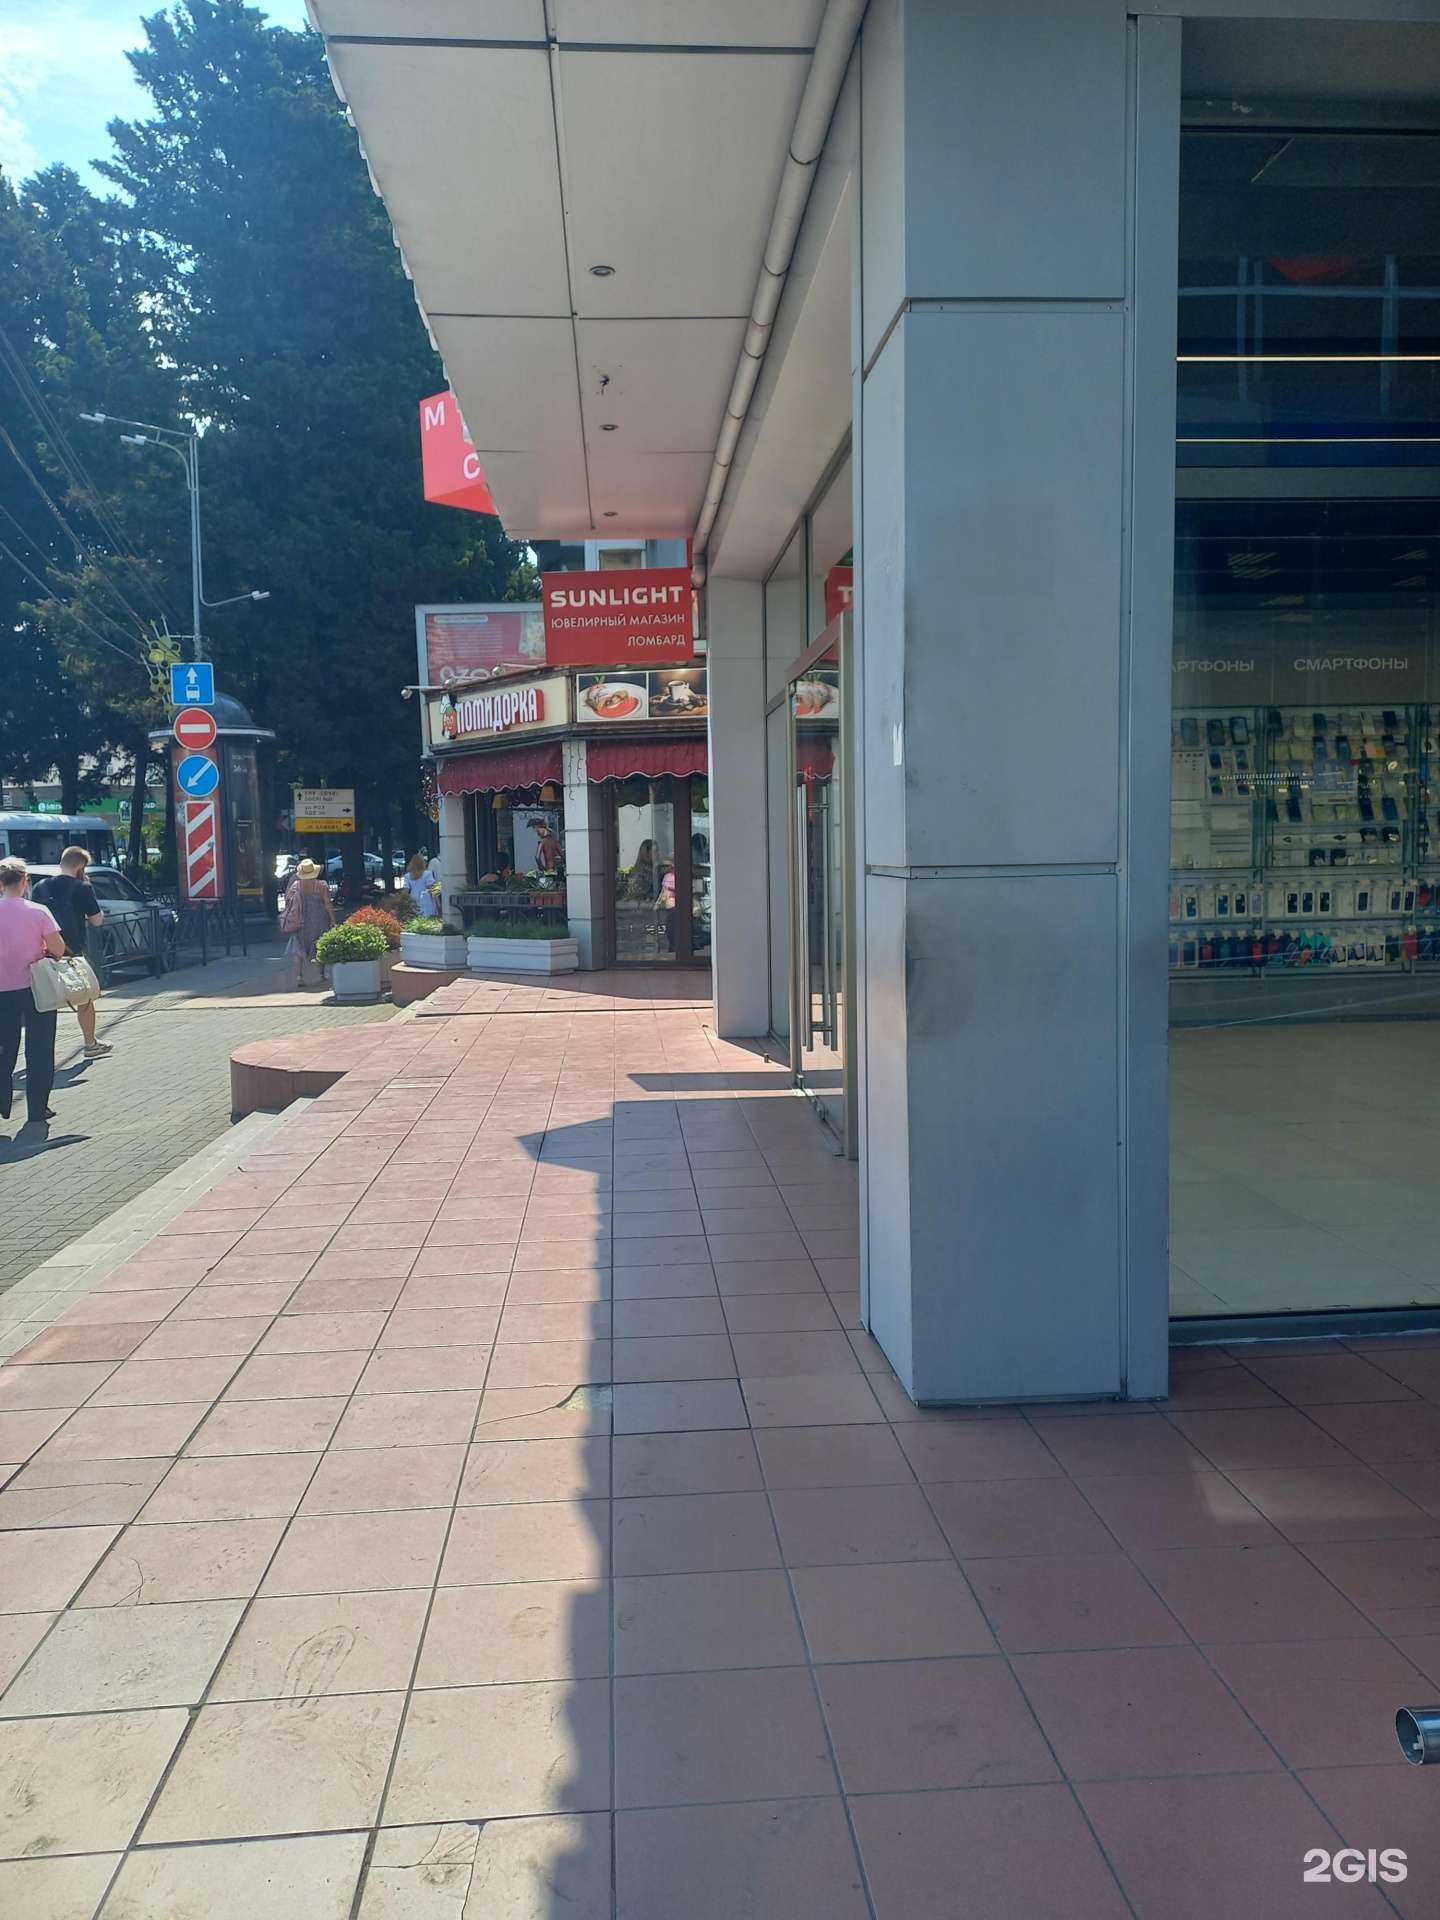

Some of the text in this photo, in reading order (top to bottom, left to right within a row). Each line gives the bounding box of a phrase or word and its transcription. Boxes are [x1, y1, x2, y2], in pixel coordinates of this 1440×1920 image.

[550, 586, 683, 608] SUNLIGHT
[551, 613, 685, 629] ЮВЕЛИРНЫЙ МАГАЗИН
[628, 634, 686, 647] ЛОМБАРД
[1294, 656, 1408, 672] СМАРТФОНЫ
[455, 688, 538, 733] ПОМИДОРКА
